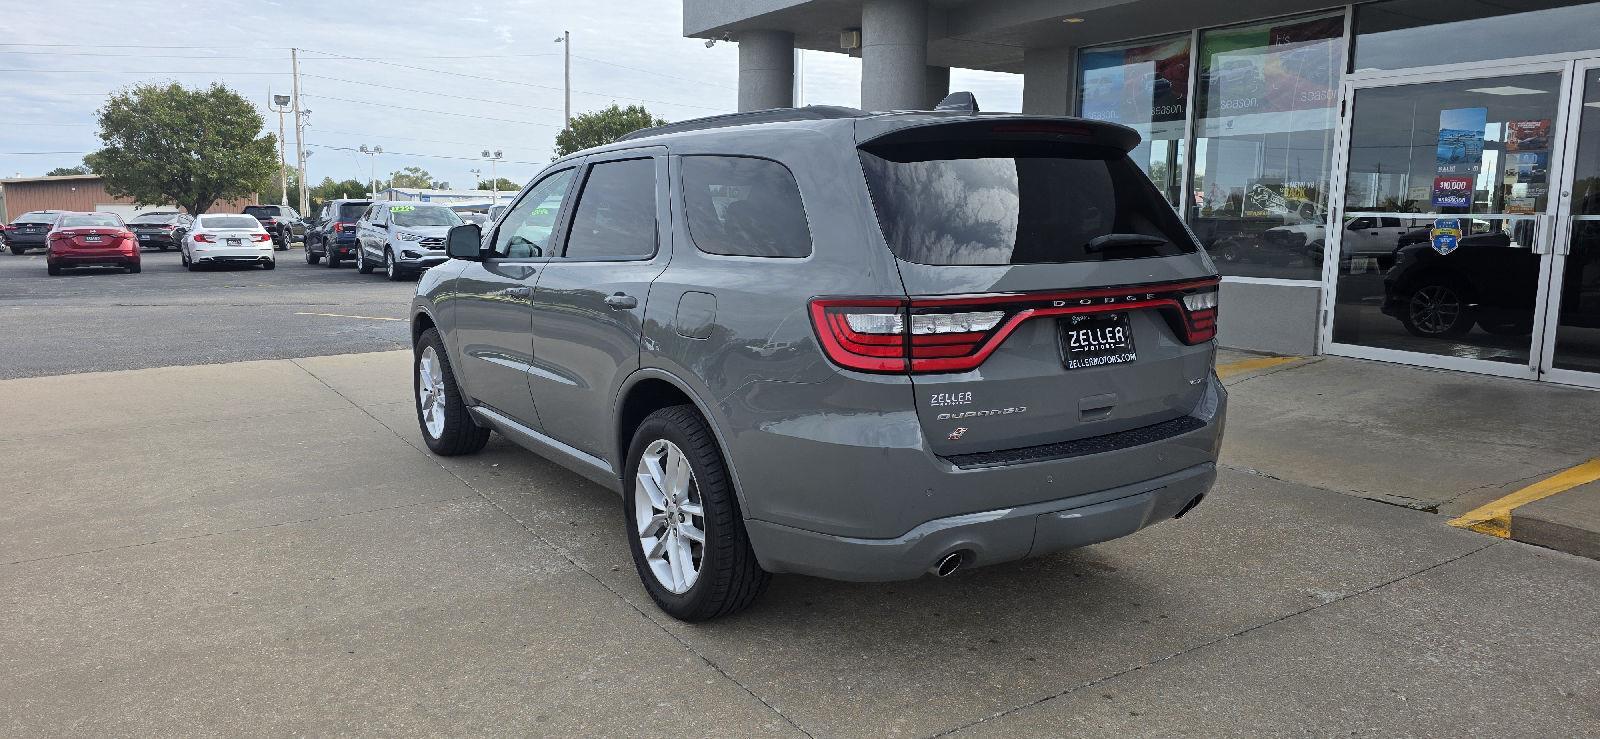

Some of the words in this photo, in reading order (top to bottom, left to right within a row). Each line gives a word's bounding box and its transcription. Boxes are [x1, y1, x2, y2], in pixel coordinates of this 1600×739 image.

[1151, 104, 1184, 116] season.
[1220, 98, 1259, 110] season.
[1053, 293, 1156, 307] DODGE
[1069, 326, 1125, 347] ZELLER
[1084, 343, 1115, 351] MOTORS
[1069, 352, 1137, 369] ZELLERMOTORS.COM
[931, 391, 972, 403] ZELLER
[937, 406, 1027, 420] DURANGO
